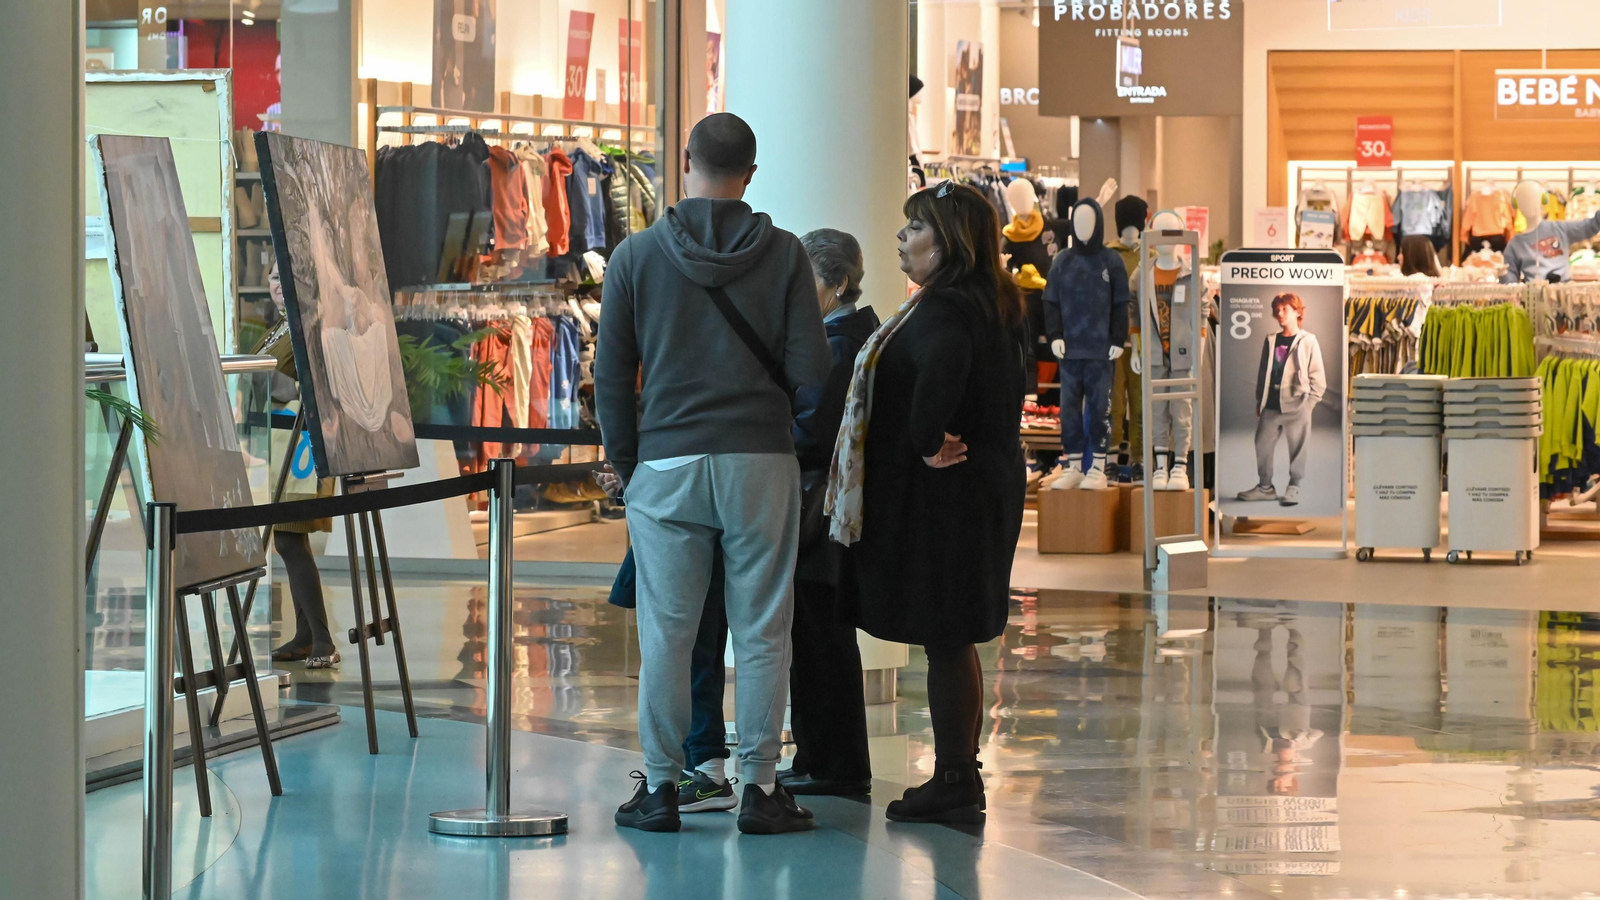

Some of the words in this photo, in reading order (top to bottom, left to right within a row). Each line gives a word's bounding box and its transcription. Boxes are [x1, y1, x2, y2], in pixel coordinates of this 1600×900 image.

[1053, 3, 1232, 22] PROBADORES
[1094, 28, 1142, 38] FITTING
[1147, 28, 1189, 38] ROOMS
[1117, 86, 1168, 97] ENTRADA
[1497, 74, 1579, 106] BEBÉ
[1267, 223, 1277, 238] 6
[1270, 254, 1295, 262] SPORT
[1231, 267, 1285, 279] PRECIO
[1289, 268, 1333, 280] WOW!
[1229, 310, 1252, 340] 8
